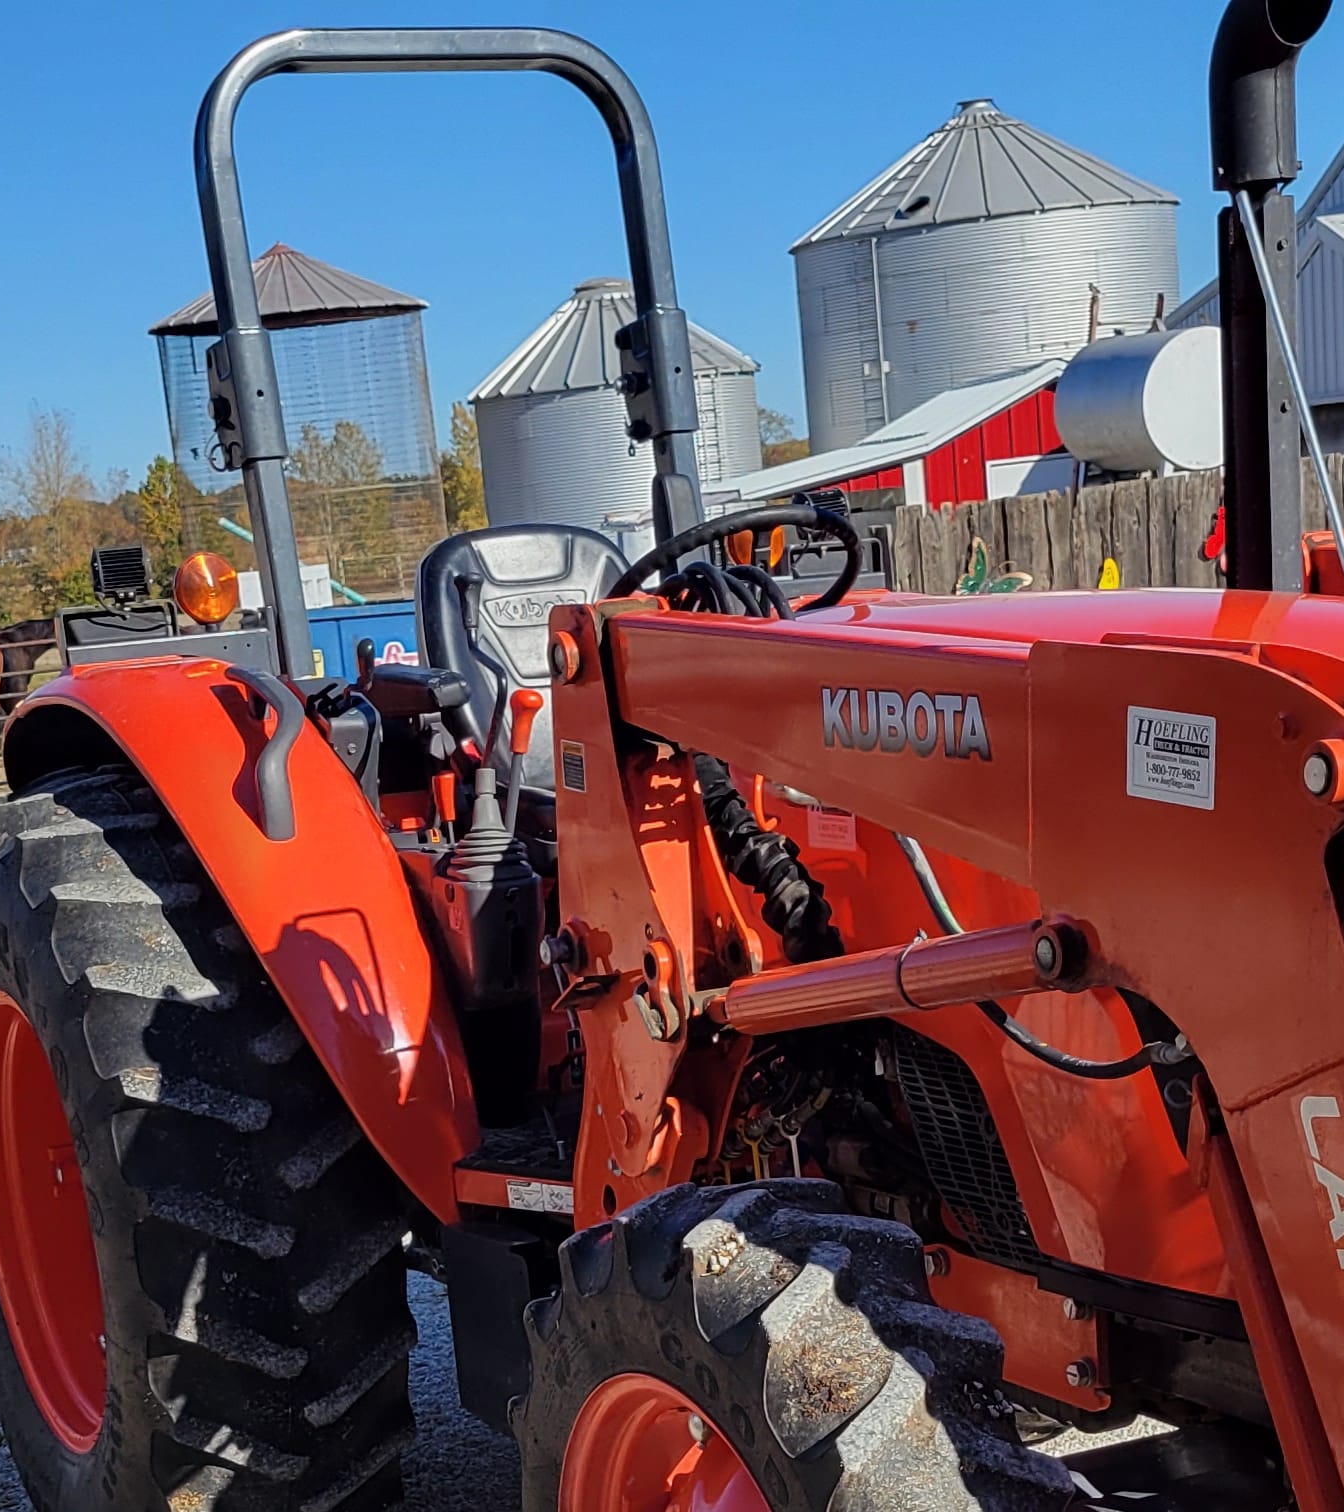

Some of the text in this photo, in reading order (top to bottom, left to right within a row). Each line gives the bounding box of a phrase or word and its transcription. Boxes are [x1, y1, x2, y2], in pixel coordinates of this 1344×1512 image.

[821, 687, 993, 762] KUBOTA
[1134, 719, 1209, 747] HOEFLING
[1145, 762, 1201, 782] 1-800-777-9852
